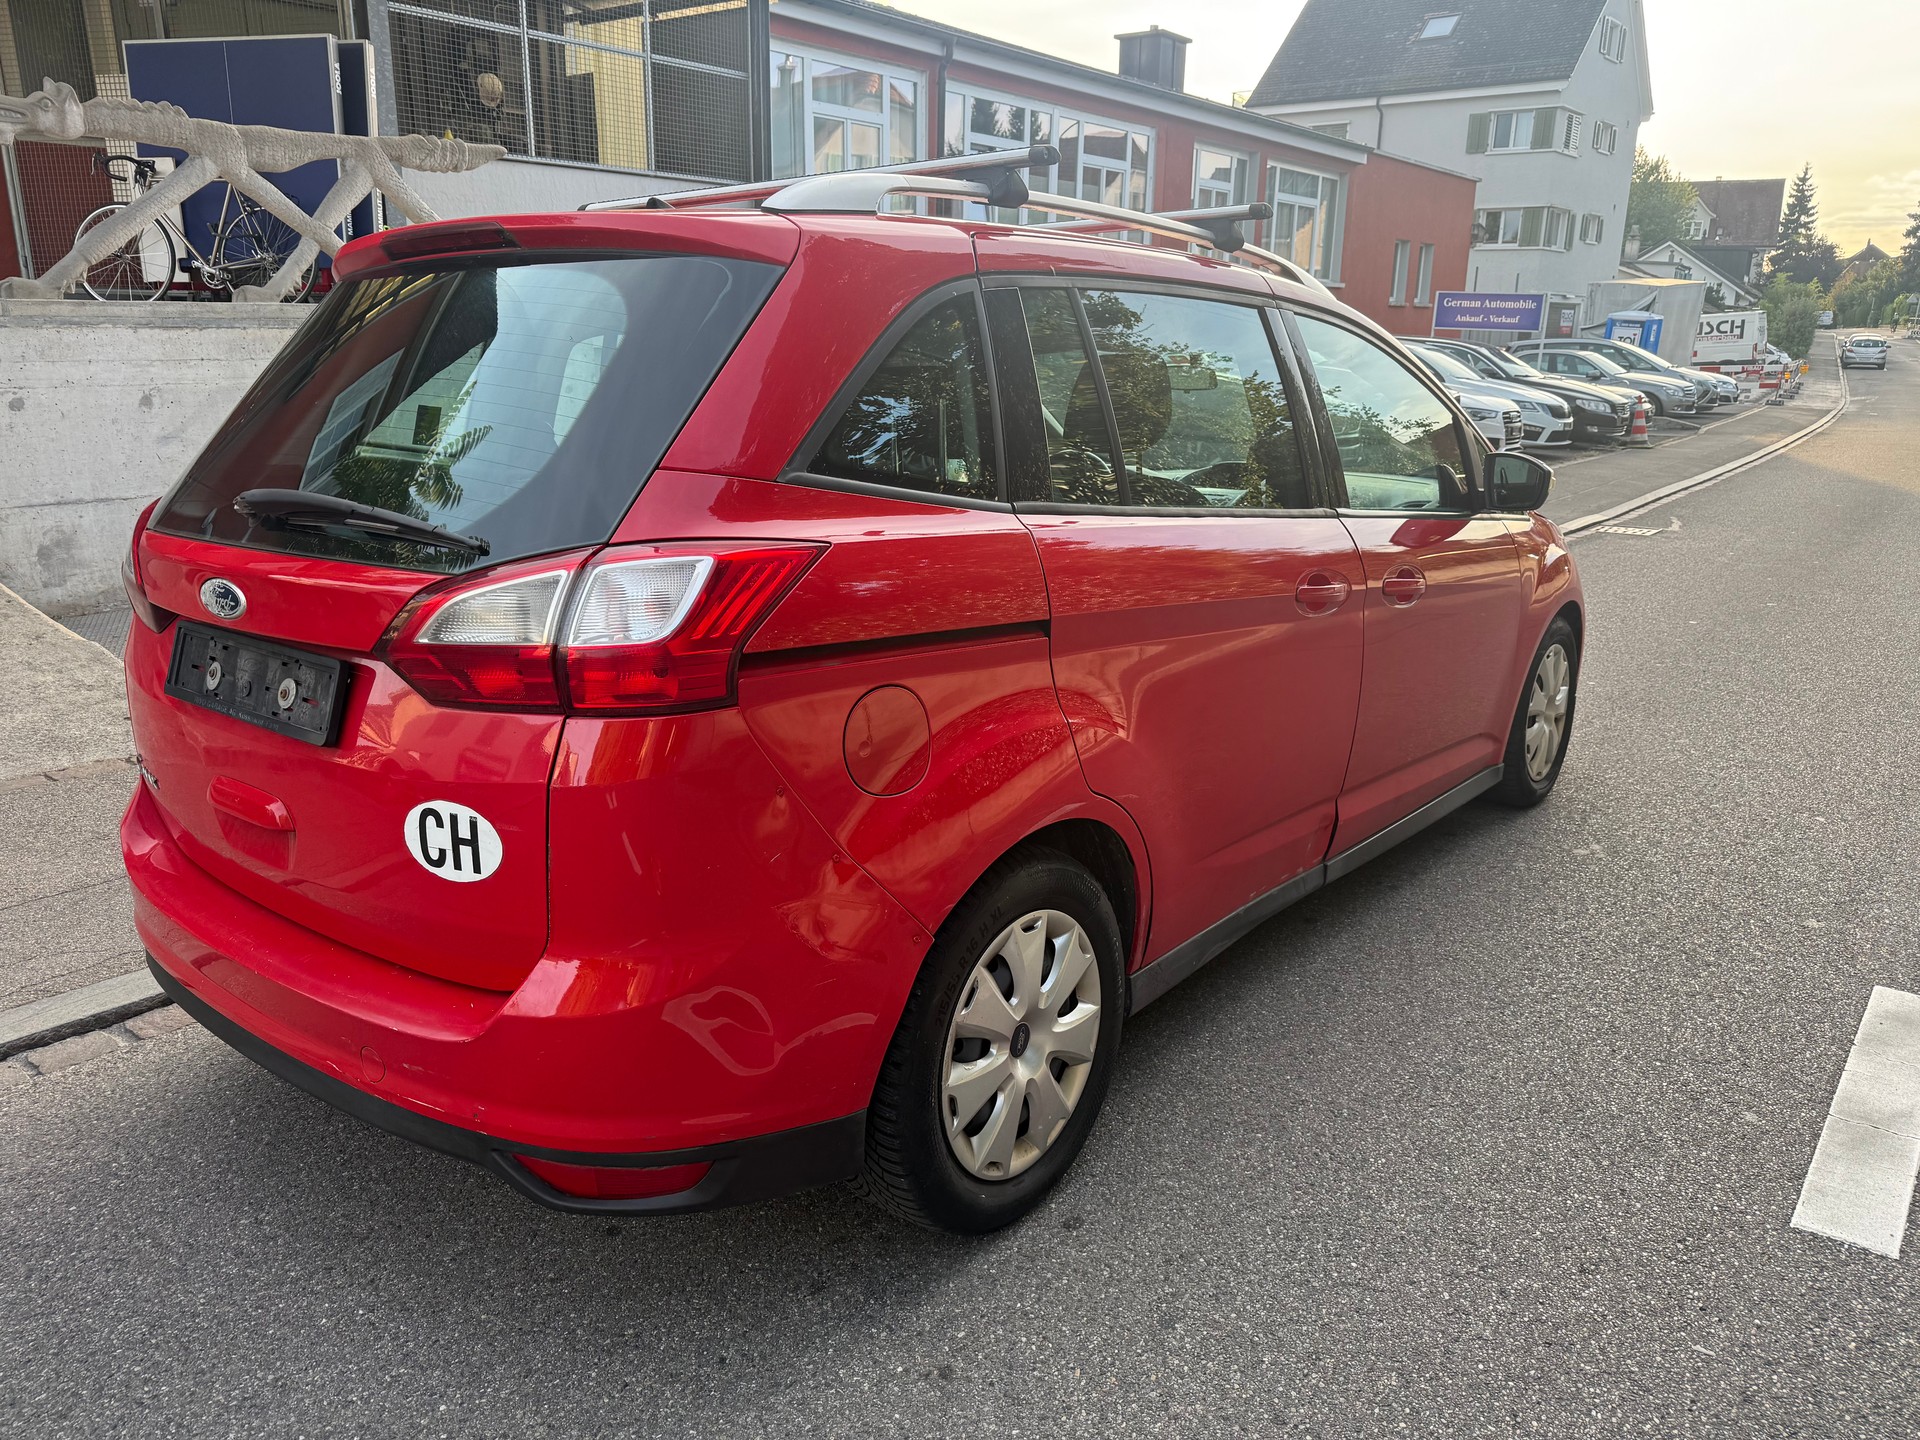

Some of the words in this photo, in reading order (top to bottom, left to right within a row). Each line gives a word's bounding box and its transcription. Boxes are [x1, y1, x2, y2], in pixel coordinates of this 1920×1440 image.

[334, 62, 342, 95] JOOLA
[1443, 297, 1481, 308] German
[1482, 299, 1537, 309] Automobile
[1455, 314, 1484, 322] Ankauf
[1489, 315, 1520, 323] Verkauf
[418, 807, 482, 875] CH
[935, 974, 961, 1029] 215/55
